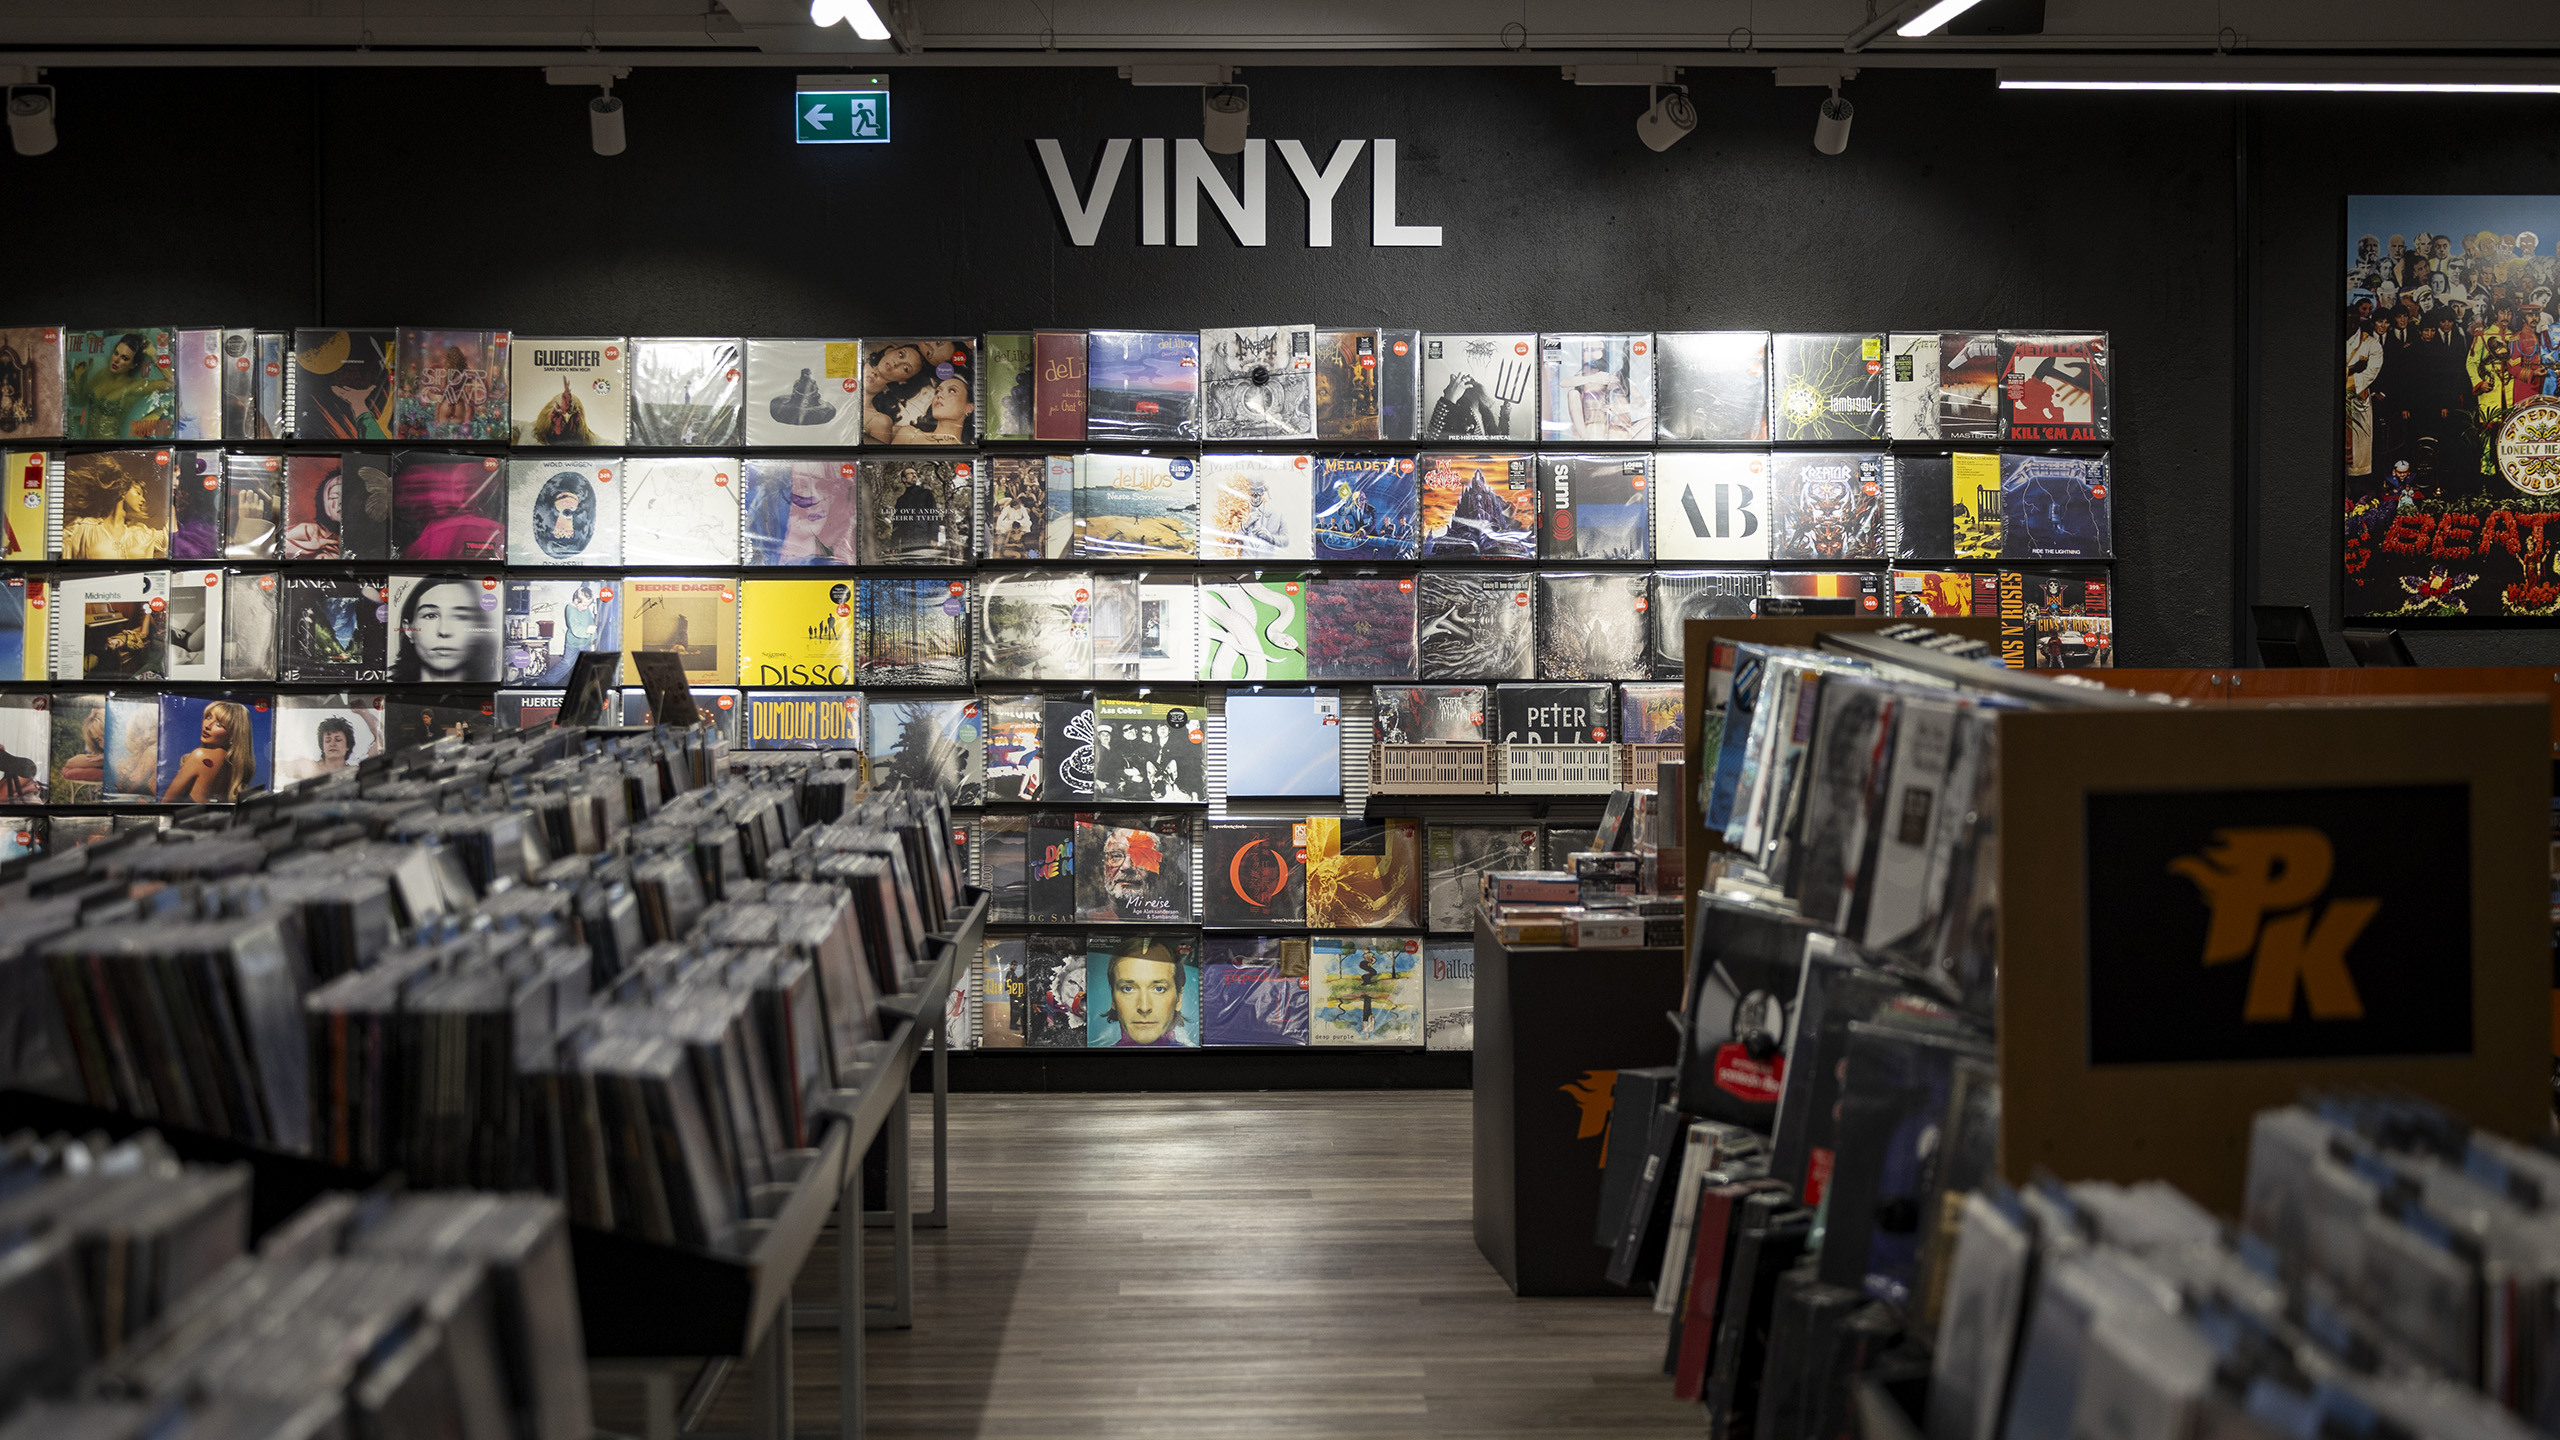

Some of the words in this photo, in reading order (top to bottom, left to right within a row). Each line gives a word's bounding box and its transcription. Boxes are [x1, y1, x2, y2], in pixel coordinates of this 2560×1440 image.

[1034, 138, 1443, 246] VINYL
[534, 350, 601, 367] GLUECIFER
[2011, 427, 2040, 440] KILL
[2071, 427, 2096, 440] ALL
[2501, 445, 2541, 456] LONELY
[1323, 458, 1402, 477] MEGADETH
[1799, 464, 1852, 482] KREATOR
[2507, 461, 2542, 490] CLUB
[1112, 466, 1172, 491] deLillos
[287, 578, 337, 589] LINNEA
[635, 584, 679, 592] BEDRE
[681, 584, 726, 592] DAGER
[85, 591, 121, 601] Midnights
[2001, 572, 2024, 620] ROSES
[2038, 618, 2060, 632] GUNS
[2072, 618, 2097, 632] ROSES
[1100, 707, 1115, 715] Ass
[1117, 707, 1142, 715] Cobra
[1528, 703, 1586, 728] PETER
[753, 701, 816, 740] DUMDUM
[820, 701, 857, 740] BOYS
[1126, 896, 1143, 909] Mi
[1144, 897, 1170, 908] reise
[985, 978, 1004, 995] The
[1333, 1034, 1354, 1042] purple
